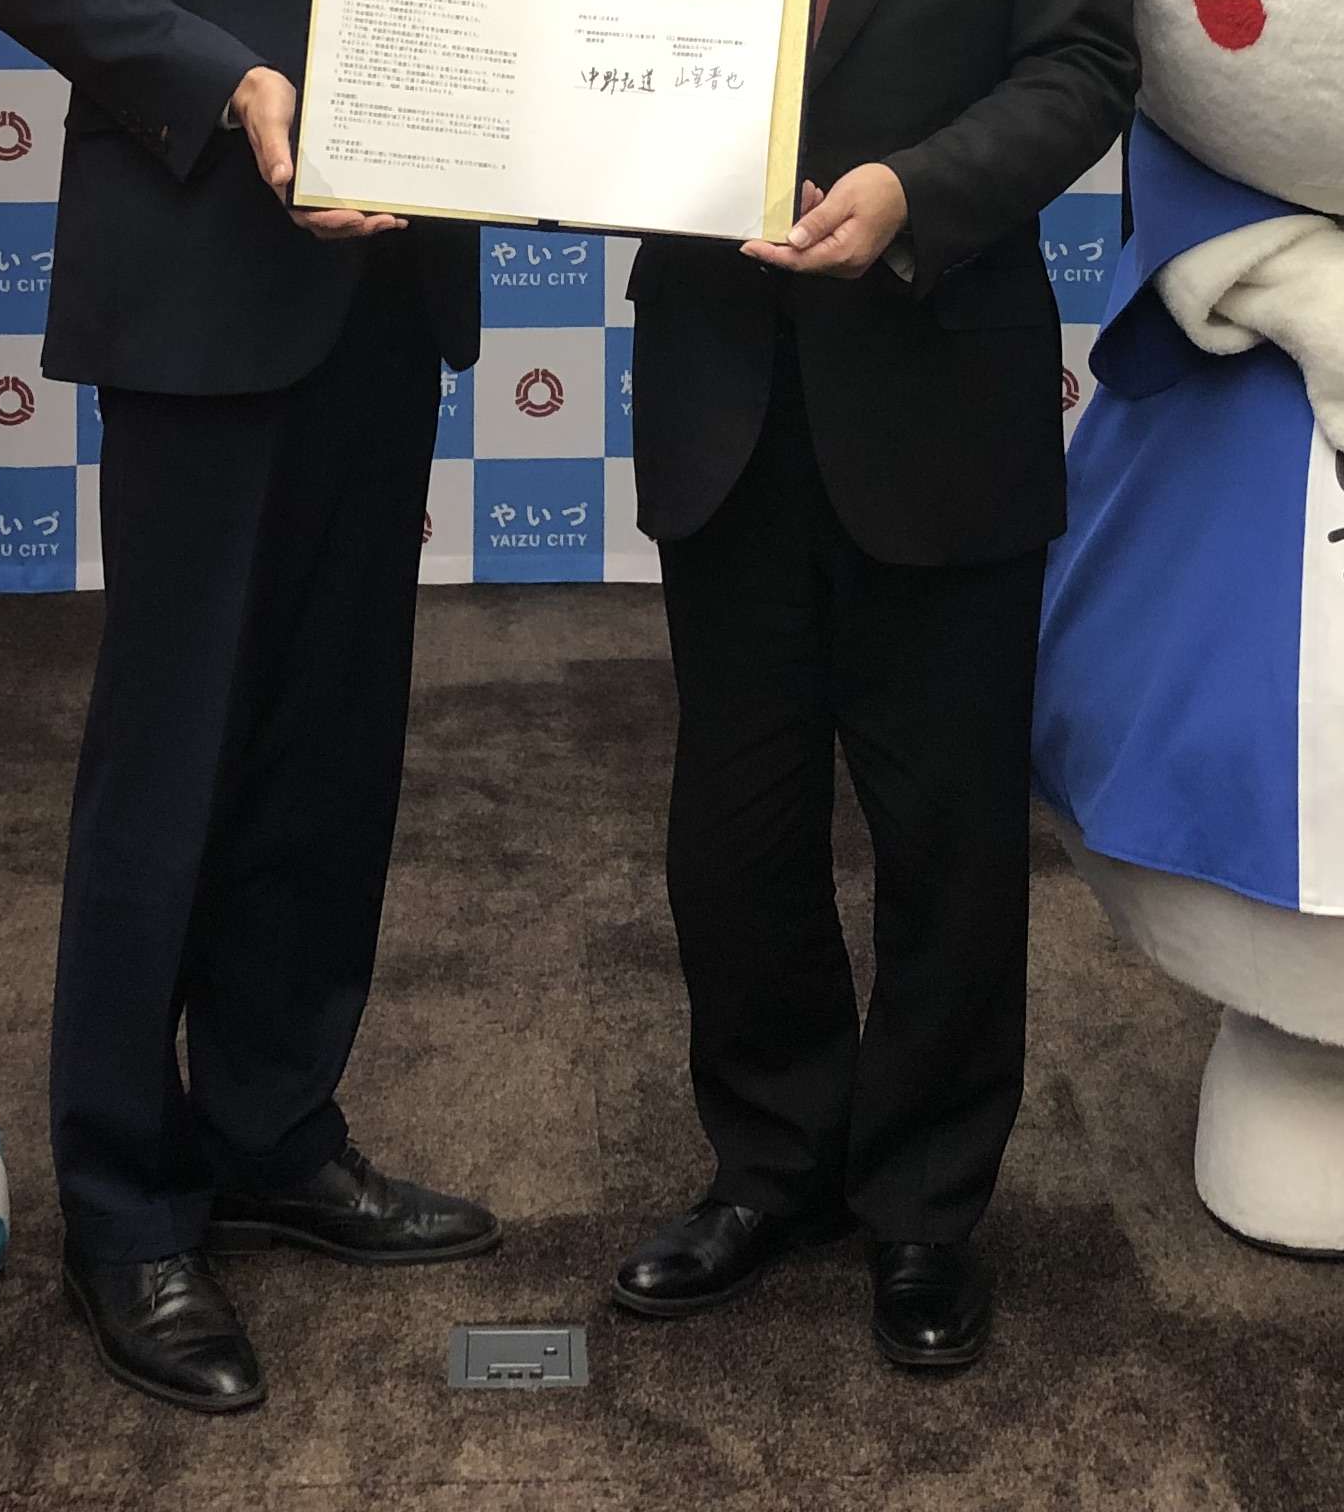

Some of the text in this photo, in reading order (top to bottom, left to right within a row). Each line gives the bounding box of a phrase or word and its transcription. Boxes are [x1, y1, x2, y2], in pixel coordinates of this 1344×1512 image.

[491, 241, 589, 267] やいづ
[1044, 237, 1105, 262] いづ
[490, 273, 588, 286] YAIZU CITY
[1063, 269, 1105, 282] CITY
[490, 502, 588, 528] やいづ
[490, 534, 588, 547] YAIZU CITY
[19, 543, 61, 558] CITY
